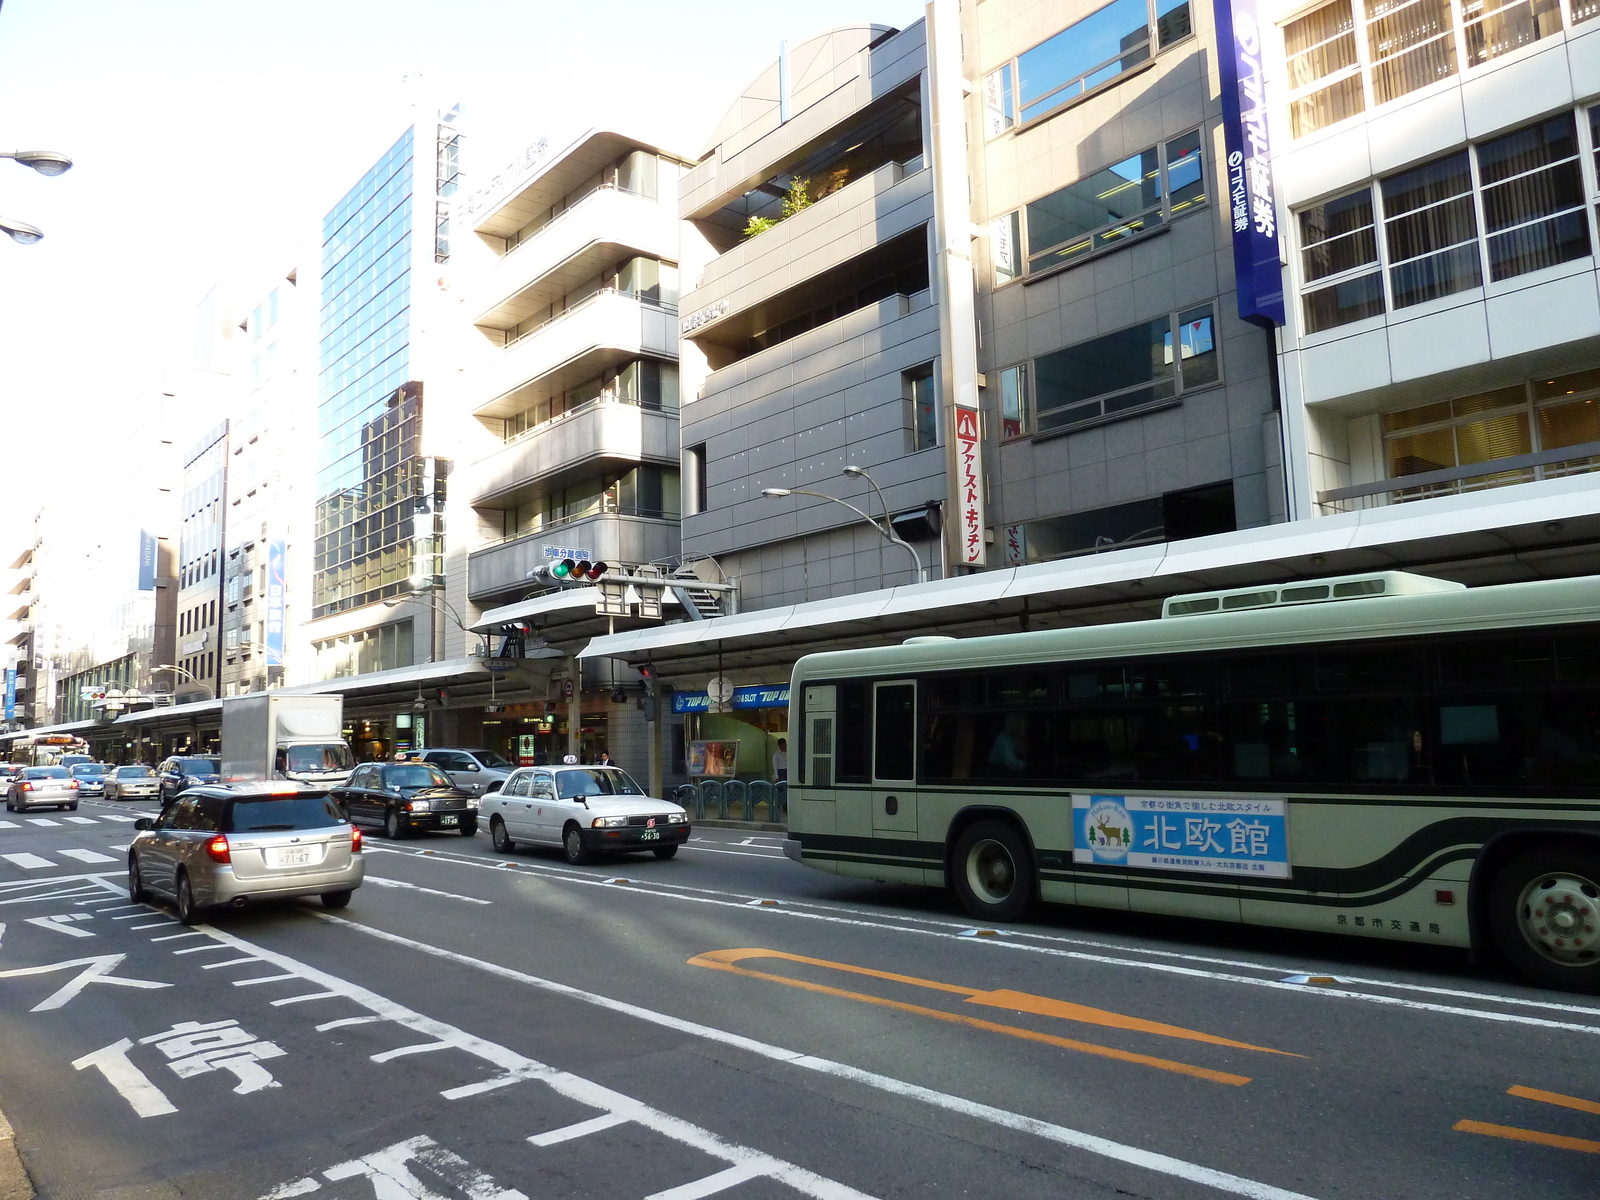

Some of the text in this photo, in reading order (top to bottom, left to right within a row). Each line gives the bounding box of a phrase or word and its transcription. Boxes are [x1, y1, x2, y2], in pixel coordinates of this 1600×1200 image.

[1240, 52, 1275, 238] コスモ証券
[1230, 166, 1249, 233] コスモ証券
[960, 440, 981, 563] ファースト・キッチン
[544, 547, 590, 560] 歩車分離信号
[685, 696, 702, 707] TOP
[759, 691, 780, 702] TOP
[1140, 800, 1272, 812] 京都の街角で愉しむ北欧スタイル
[1143, 814, 1271, 857] 北欧館
[284, 853, 309, 864] 71-67
[1336, 914, 1440, 934] 京都市交通局
